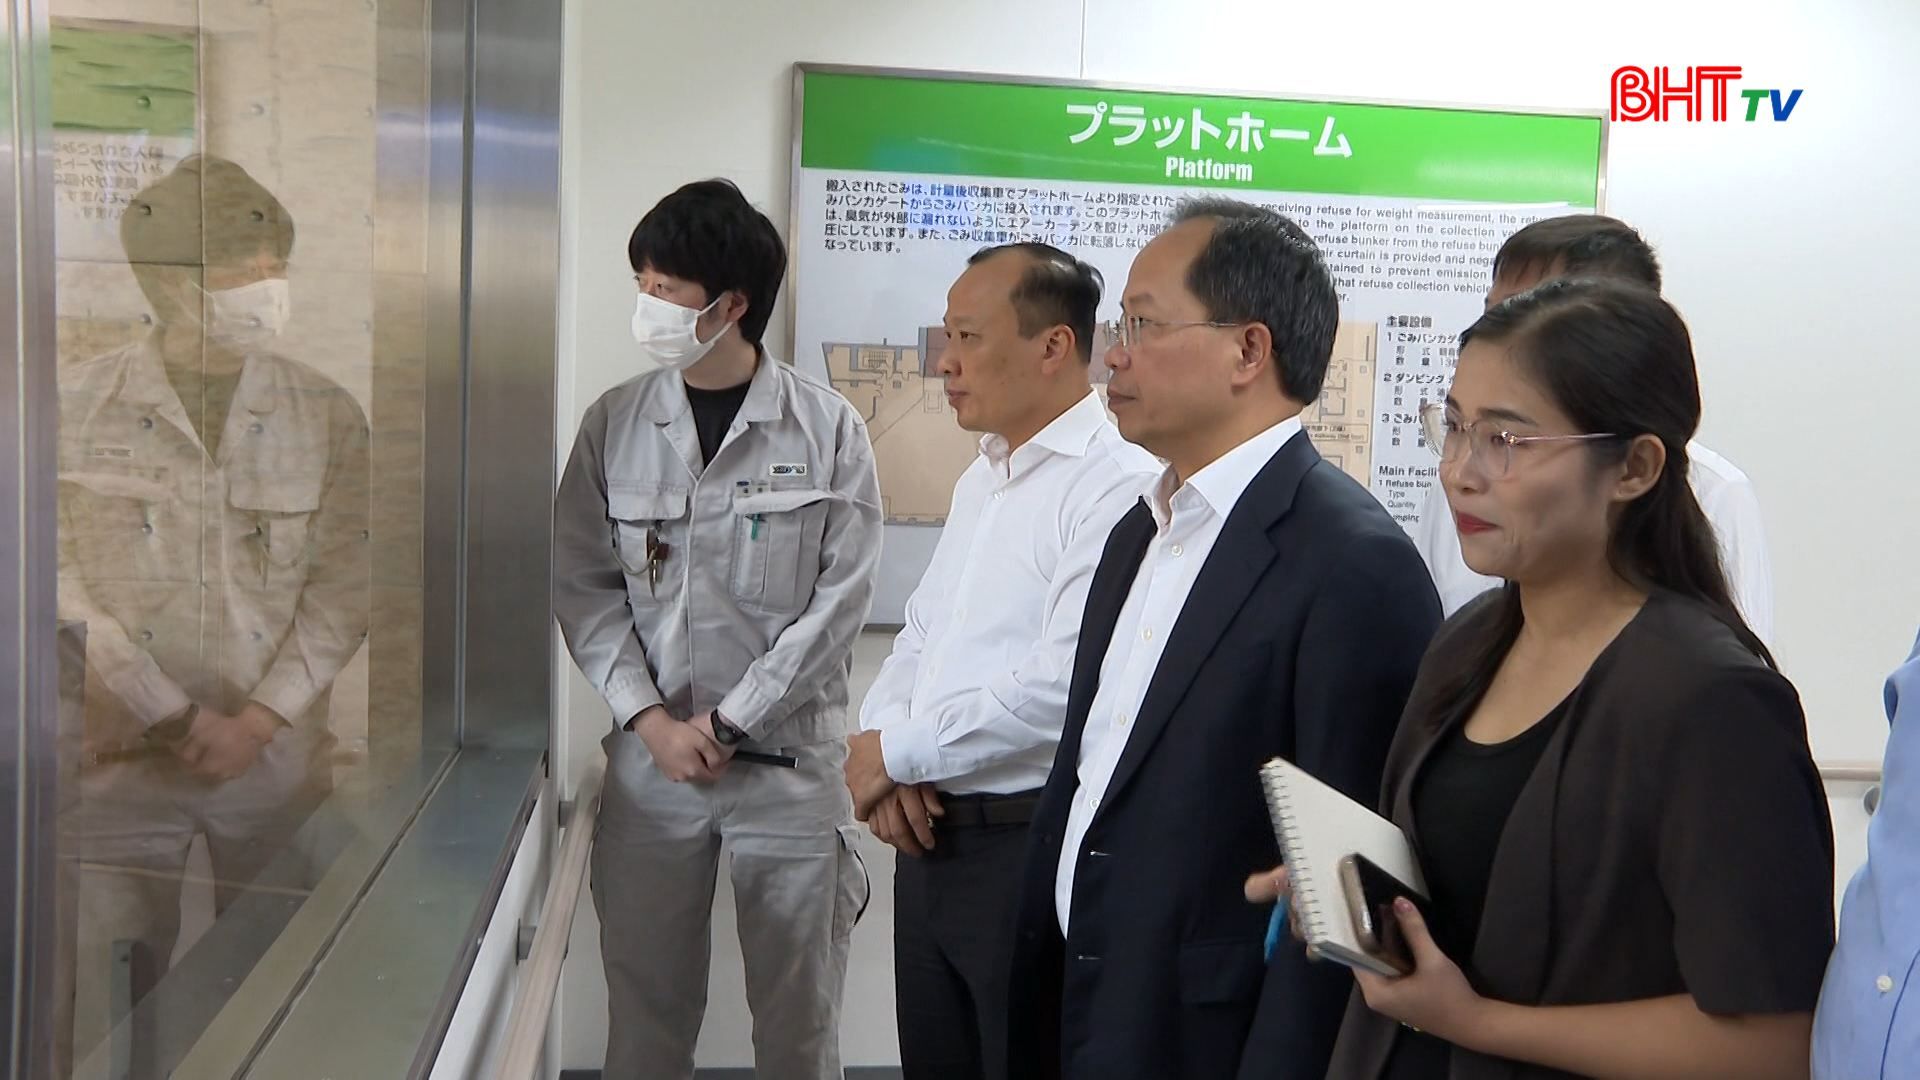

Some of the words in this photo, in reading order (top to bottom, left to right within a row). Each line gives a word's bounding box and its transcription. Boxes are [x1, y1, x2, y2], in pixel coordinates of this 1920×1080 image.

[1066, 101, 1352, 158] プラットホーム
[1165, 155, 1254, 182] Platform
[1317, 205, 1352, 216] refuse
[1356, 204, 1372, 216] for
[1376, 207, 1413, 220] weight
[1417, 209, 1494, 224] measurement,
[1499, 213, 1516, 224] the
[1316, 219, 1334, 229] the
[1341, 219, 1388, 232] platform
[1395, 225, 1409, 233] on
[1416, 224, 1434, 234] the
[1440, 224, 1495, 237] collection
[1314, 234, 1348, 244] refuse
[1352, 234, 1390, 245] bunker
[1393, 238, 1418, 248] from
[1421, 239, 1439, 249] the
[1441, 239, 1476, 250] refuse
[1337, 249, 1376, 260] curtain
[1380, 251, 1389, 260] is
[1393, 251, 1441, 263] provided
[1445, 253, 1465, 264] and
[1371, 265, 1381, 274] to
[1388, 266, 1430, 277] prevent
[1436, 267, 1487, 280] emission
[1359, 279, 1394, 289] refuse
[1397, 279, 1450, 292] collection
[1379, 465, 1405, 476] Main
[1386, 479, 1414, 487] Refuse
[1388, 489, 1405, 499] Type
